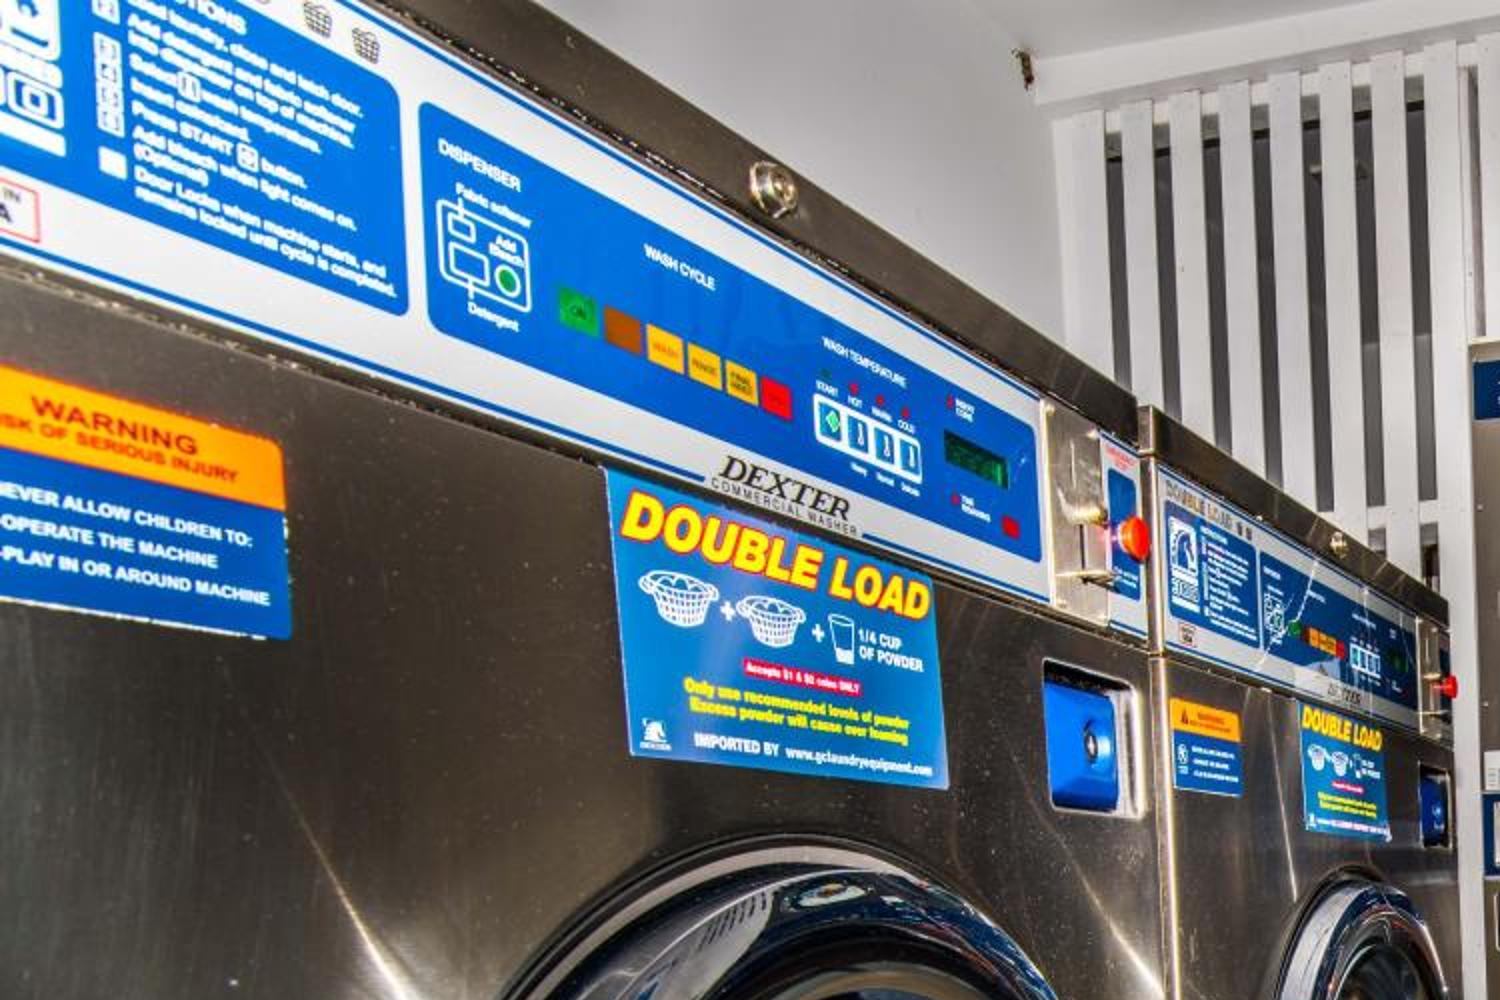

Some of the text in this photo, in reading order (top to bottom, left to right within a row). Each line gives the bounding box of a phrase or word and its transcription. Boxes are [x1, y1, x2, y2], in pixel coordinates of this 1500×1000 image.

[438, 137, 521, 192] DISPENSER
[362, 260, 387, 279] and
[644, 243, 716, 292] WASH CYCLE
[468, 301, 520, 333] Detergent
[822, 336, 908, 389] WASH TEMPERATURE
[815, 379, 839, 398] START
[848, 395, 863, 410] HOT
[31, 394, 199, 456] WARNING
[898, 418, 916, 435] COLD
[0, 412, 239, 483] ISK OF SERIOUS INJURY
[711, 477, 858, 536] COMMERCIAL WASHER
[719, 455, 850, 521] DEXTER
[62, 495, 131, 522] ALLOW
[134, 510, 222, 541] CHILDREN
[225, 528, 253, 548] TO:
[97, 531, 135, 553] THE
[138, 540, 219, 570] MACHINE
[620, 487, 931, 620] DOUBLE LOAD
[59, 555, 79, 573] IN
[83, 559, 112, 580] OR
[115, 565, 192, 593] AROUND
[195, 580, 271, 607] MACHINE
[859, 628, 903, 651] 1/4 CUP
[859, 644, 924, 672] OF POWDER
[684, 677, 714, 699] Only
[744, 688, 826, 716] recommended
[740, 707, 784, 728] powder
[844, 723, 867, 738] over
[1303, 705, 1383, 751] DOUBLE LOAD
[694, 732, 761, 756] IMPORTED
[764, 742, 780, 758] BY
